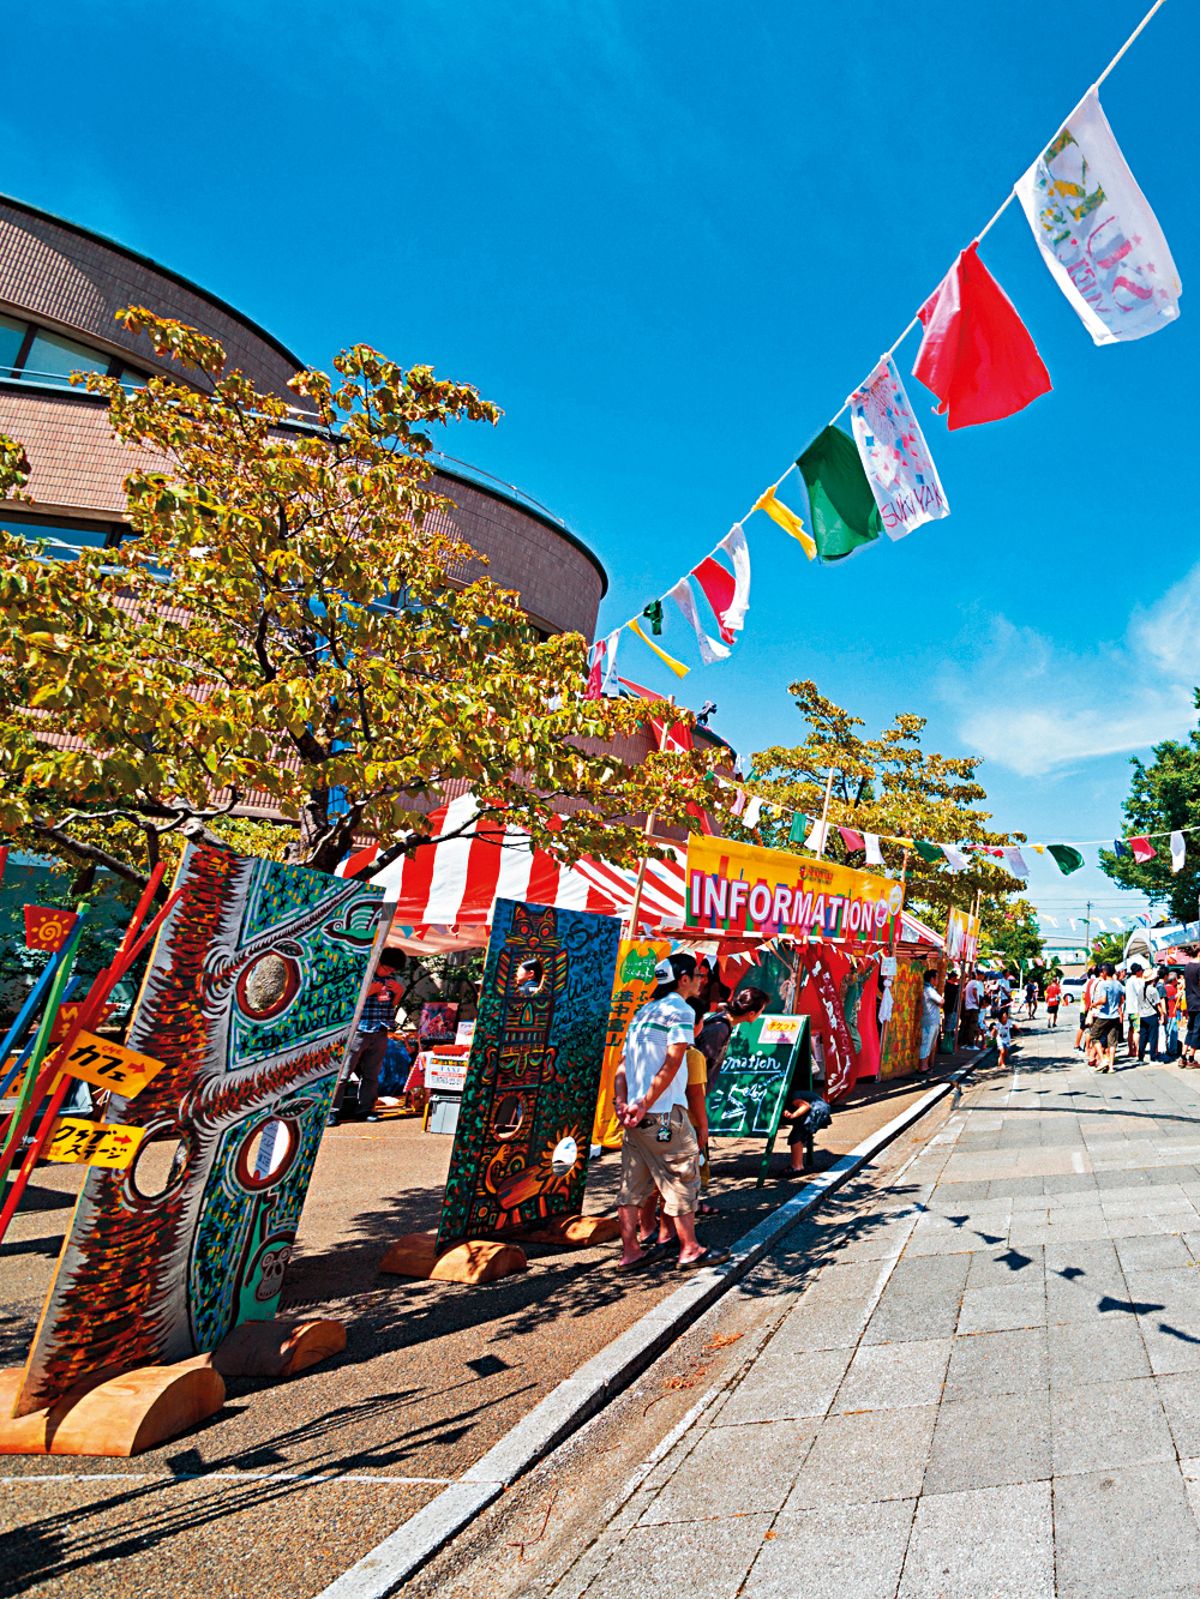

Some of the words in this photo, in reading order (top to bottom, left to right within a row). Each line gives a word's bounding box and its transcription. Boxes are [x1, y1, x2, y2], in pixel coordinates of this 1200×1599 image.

[691, 874, 874, 933] INFORMATION
[68, 1045, 126, 1082] カフェ
[52, 1125, 117, 1144] クラブ
[63, 1144, 127, 1160] ステージ
